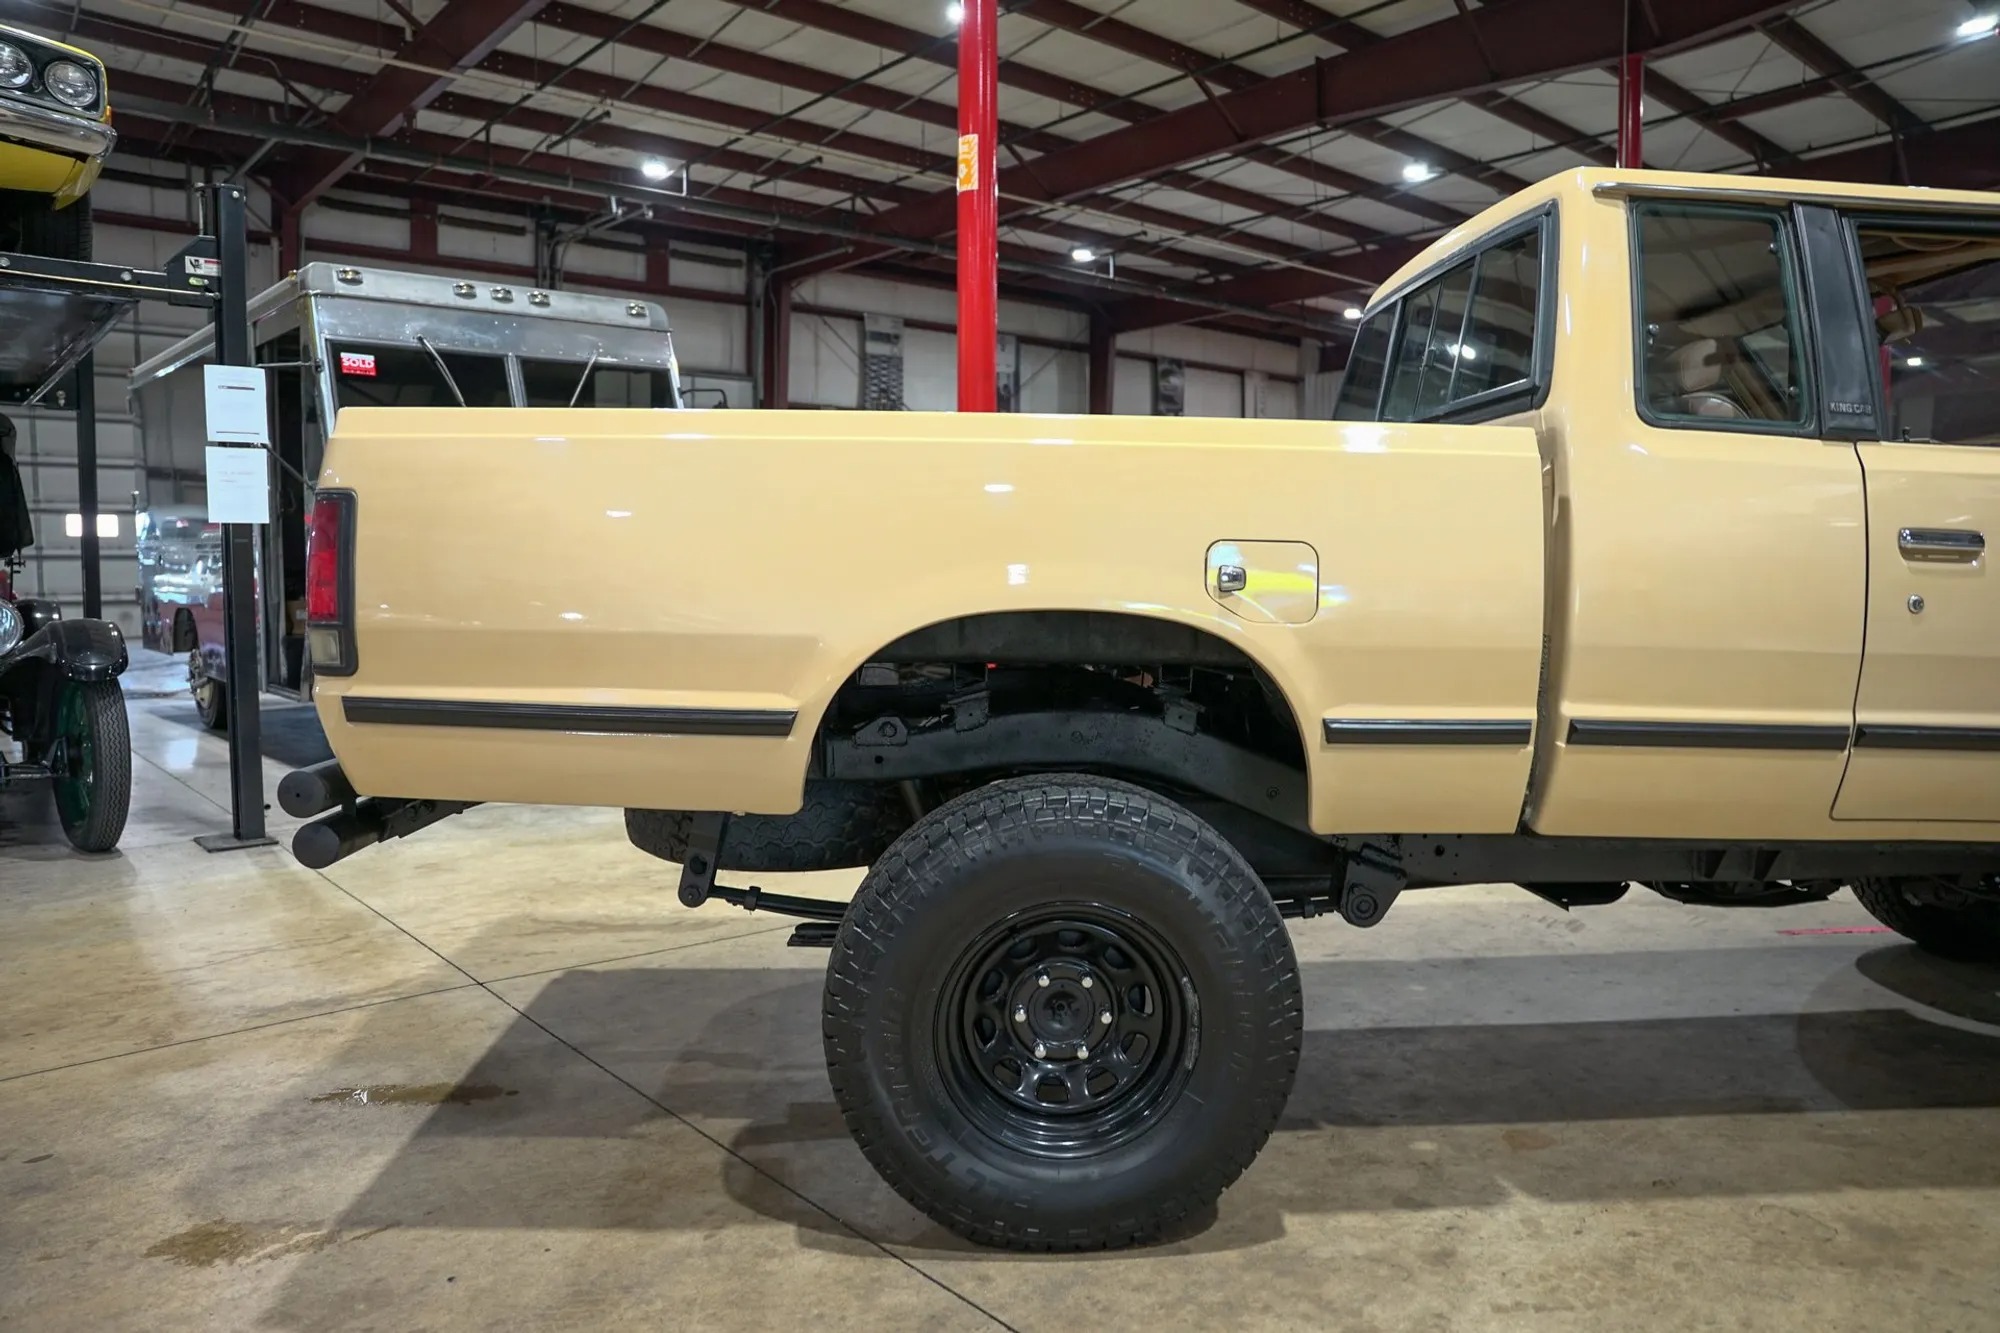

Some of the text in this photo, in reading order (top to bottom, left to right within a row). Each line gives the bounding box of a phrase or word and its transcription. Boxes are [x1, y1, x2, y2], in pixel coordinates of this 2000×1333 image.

[342, 357, 375, 368] SOLD
[1829, 402, 1872, 414] KING CAB
